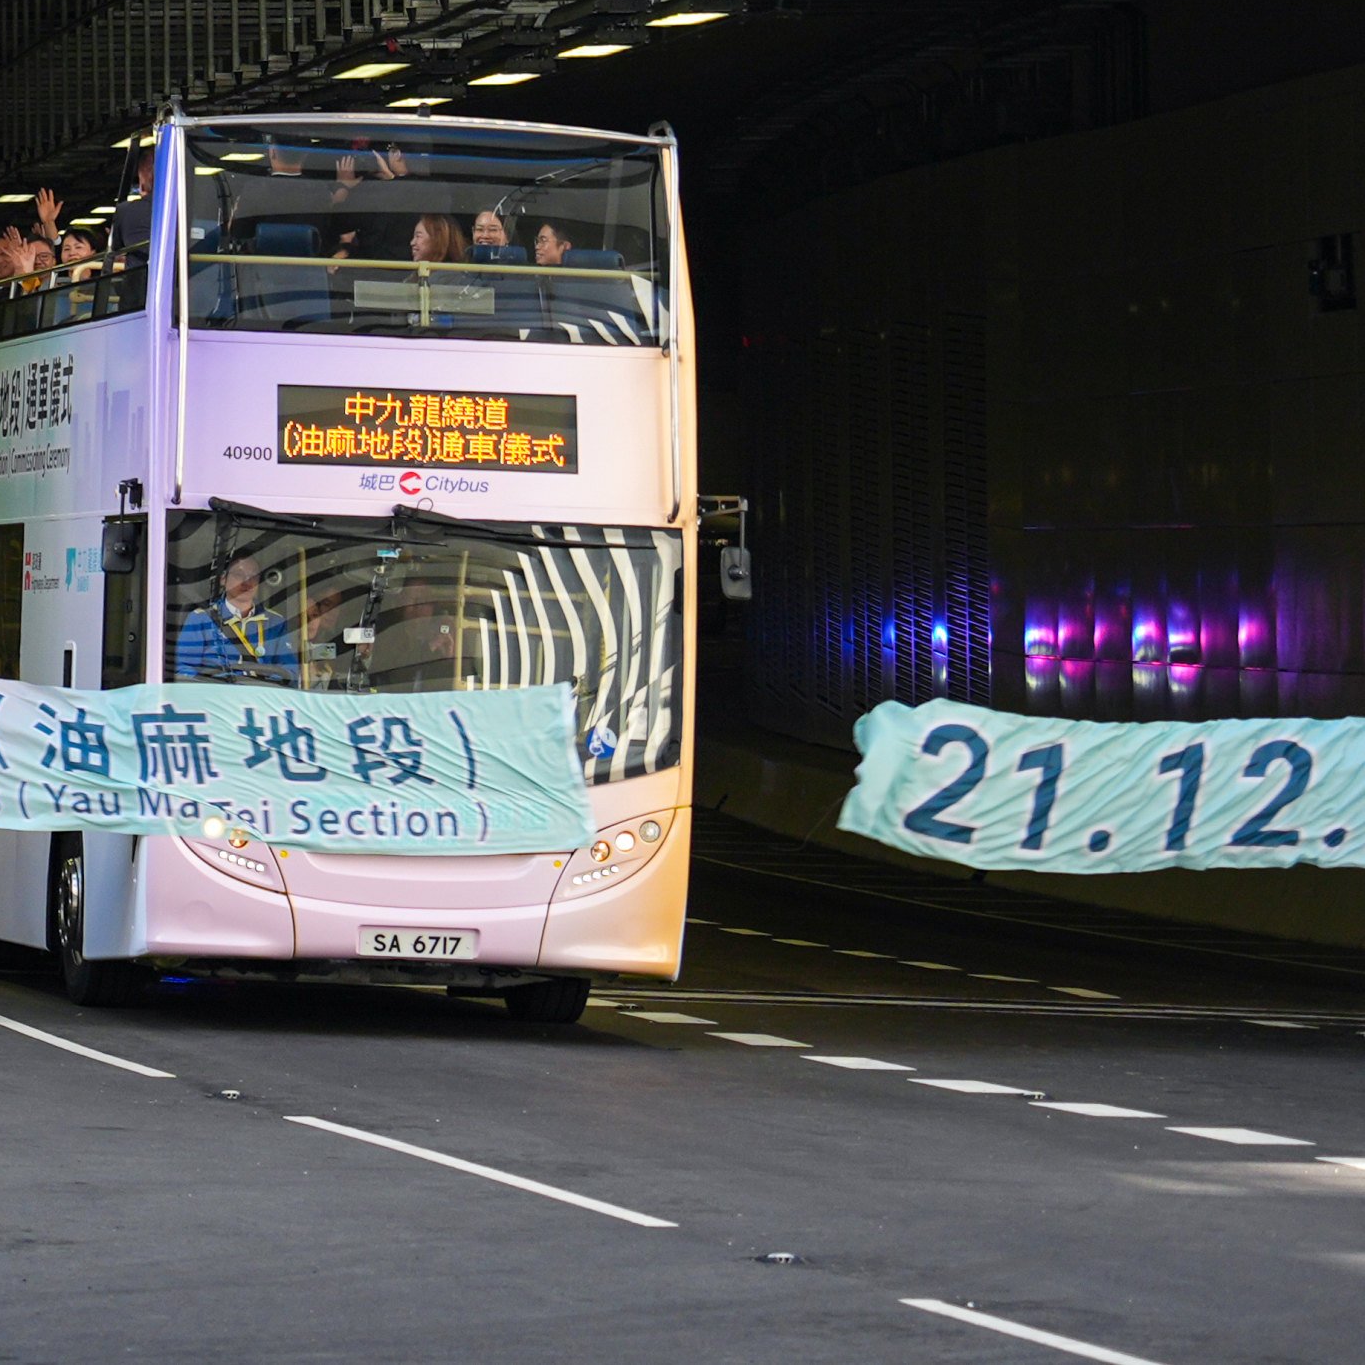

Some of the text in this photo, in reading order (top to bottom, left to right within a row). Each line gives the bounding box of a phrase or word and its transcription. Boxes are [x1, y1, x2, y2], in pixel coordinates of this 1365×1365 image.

[344, 391, 509, 429] 中九龍繞道
[223, 446, 273, 461] 40900
[283, 420, 565, 467] (油麻地段)通車儀式
[360, 473, 395, 492] 城巴
[425, 475, 489, 494] Citybus
[44, 782, 121, 818] Yau
[138, 787, 199, 821] Ma
[290, 799, 459, 837] Section
[374, 934, 462, 955] SA 6717
